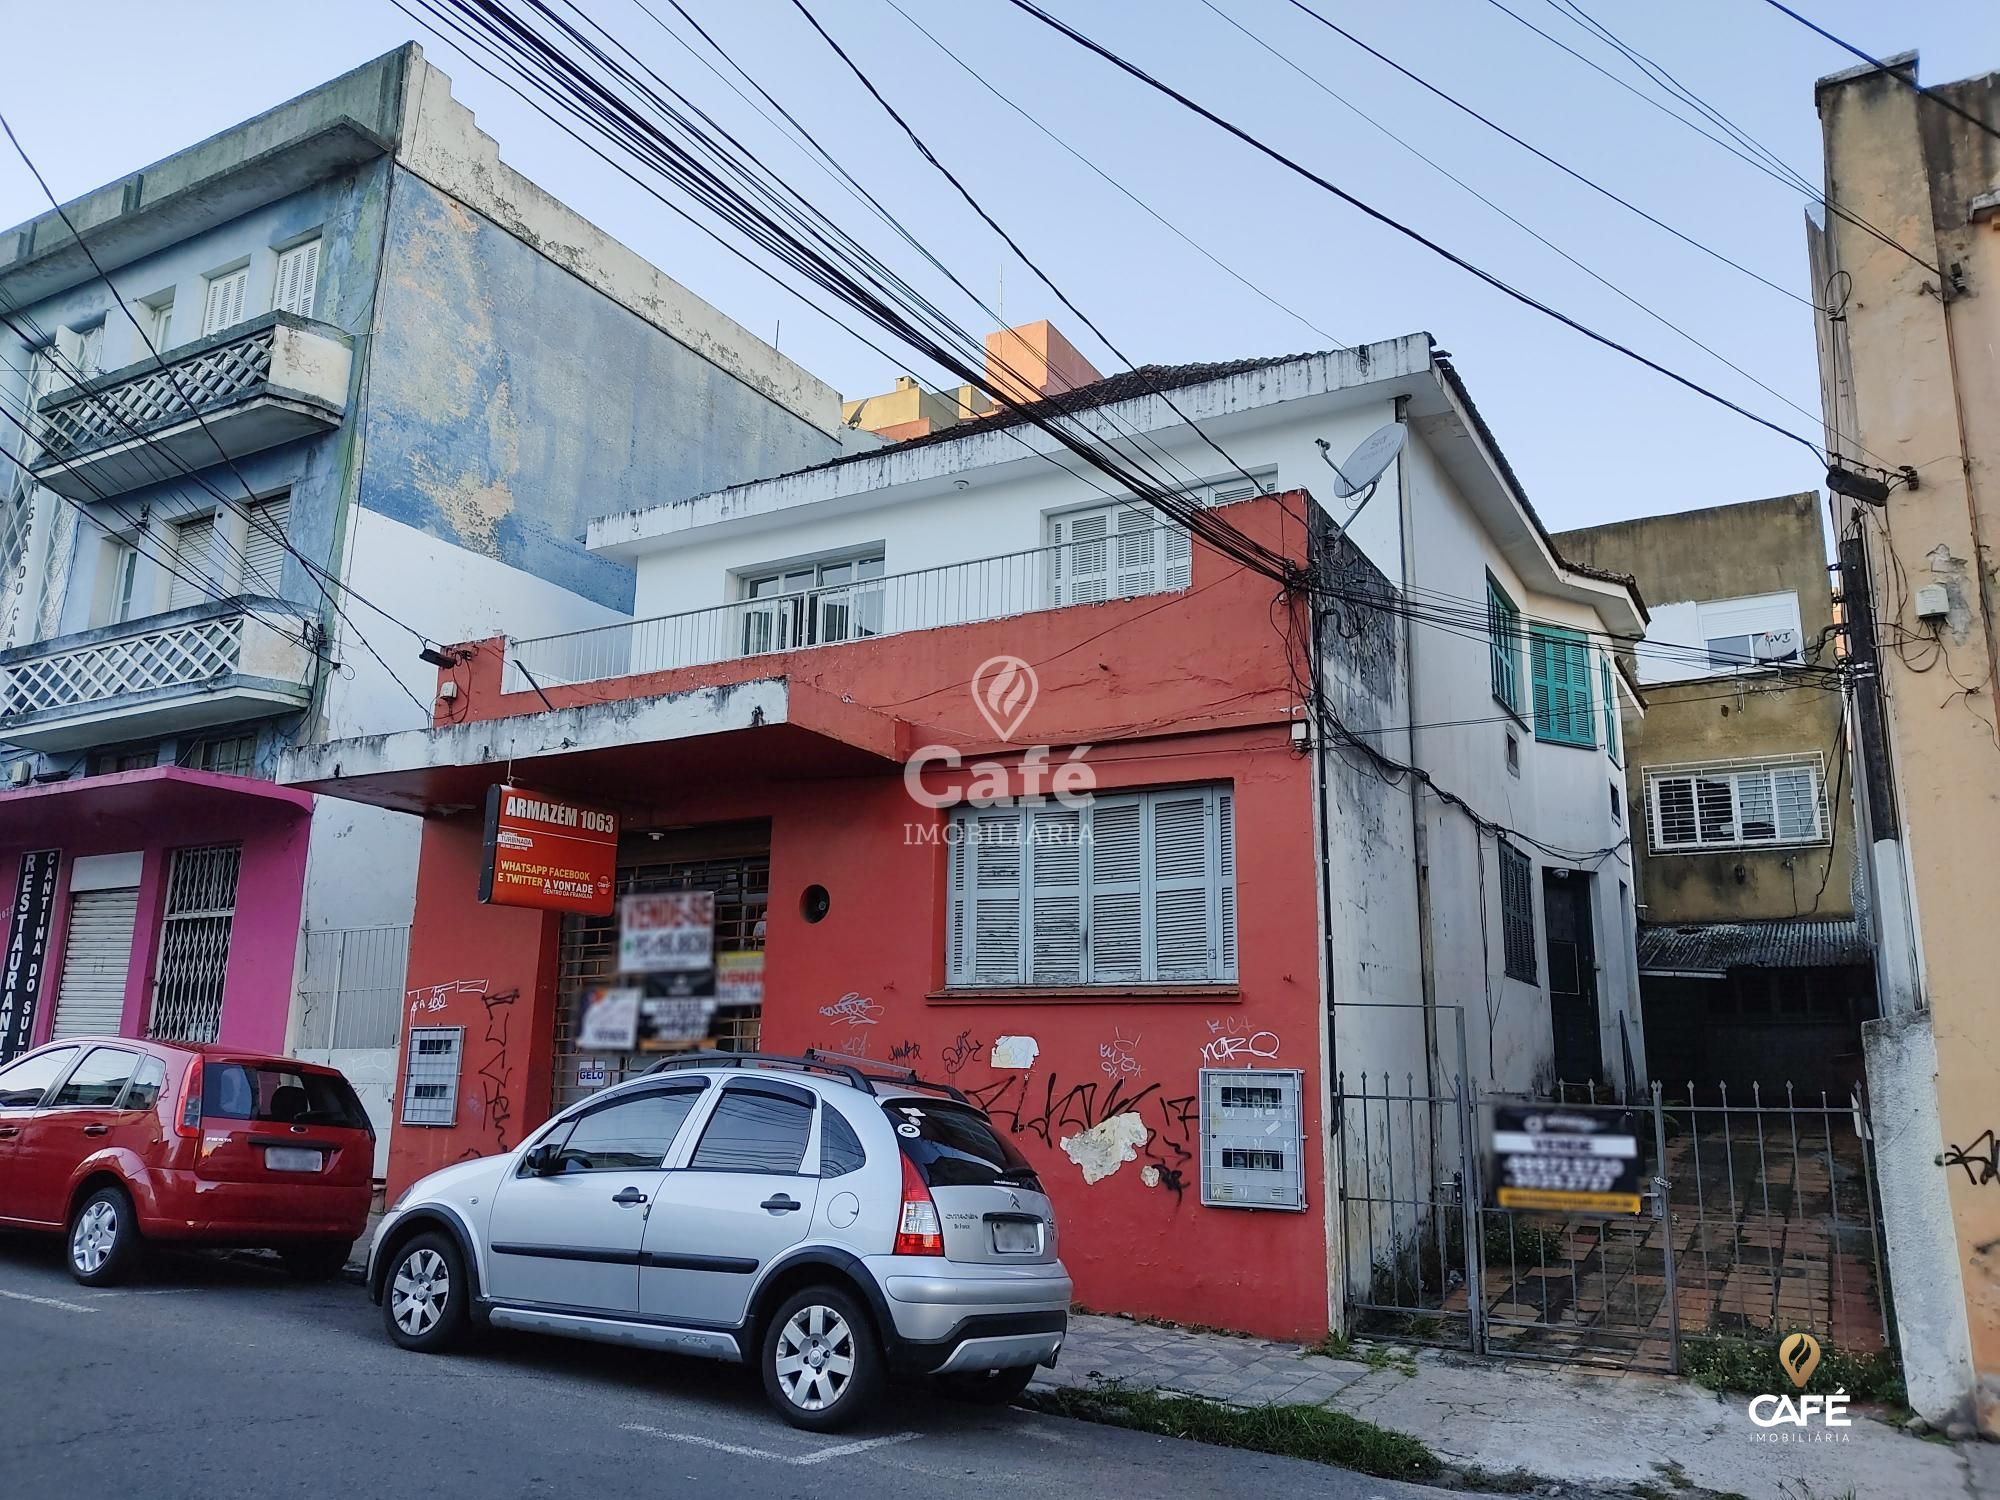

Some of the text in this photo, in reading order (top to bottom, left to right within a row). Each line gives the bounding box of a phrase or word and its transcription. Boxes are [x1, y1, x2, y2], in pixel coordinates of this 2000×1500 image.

[505, 796, 614, 833] ARMAZÉM 1063
[498, 872, 504, 882] E
[507, 873, 542, 887] TWITTER
[553, 880, 593, 894] VONTADE
[501, 860, 590, 881] WHATSAPP FACEBOOK
[32, 852, 55, 956] CANTINA
[26, 963, 38, 993] DO
[17, 1000, 31, 1046] SUL
[580, 1072, 604, 1080] GELO
